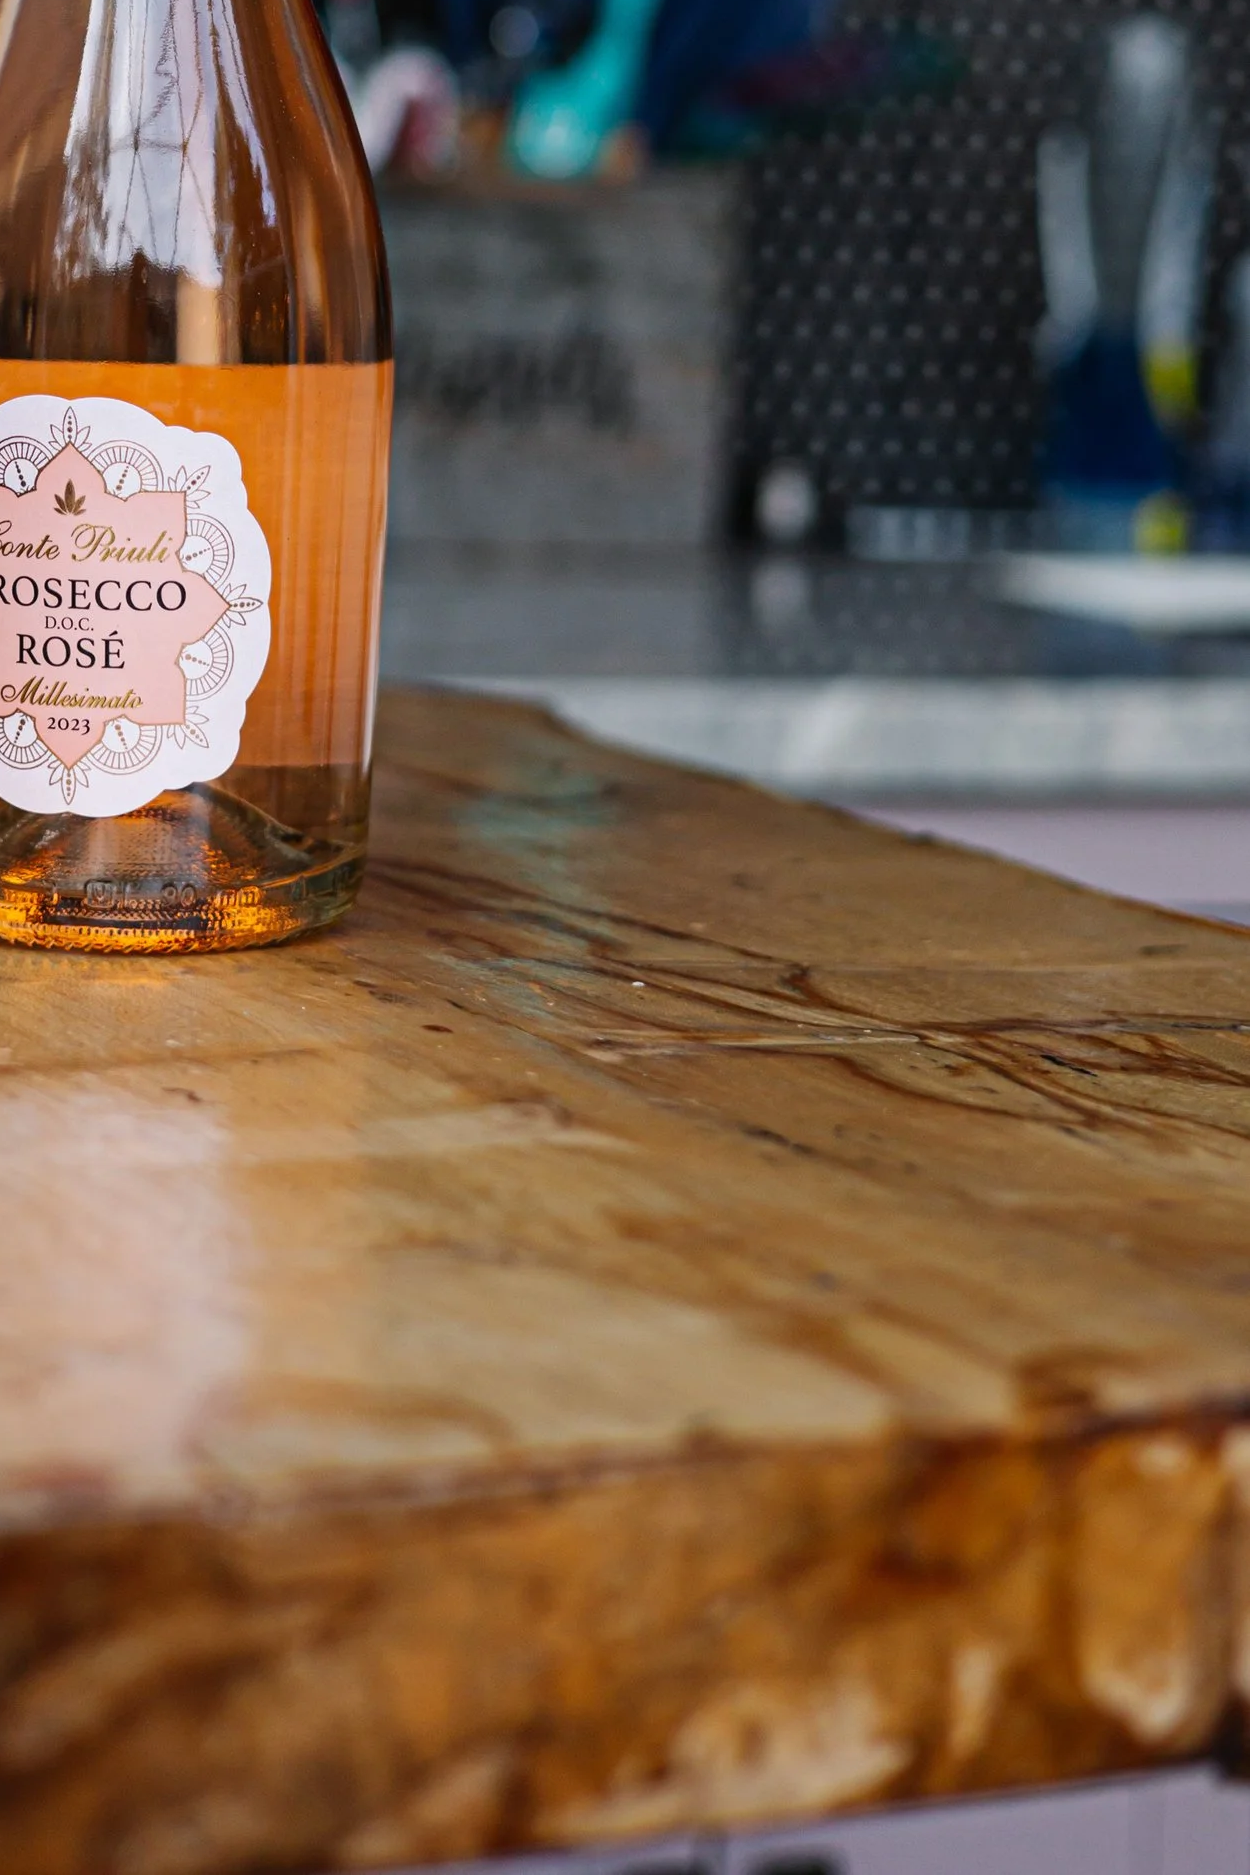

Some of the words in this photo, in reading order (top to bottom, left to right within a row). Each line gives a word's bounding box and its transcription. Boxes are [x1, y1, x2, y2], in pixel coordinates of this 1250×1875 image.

[71, 523, 173, 563] Priuli
[44, 616, 94, 631] D.O.C.
[16, 630, 125, 669] ROSÉ
[1, 675, 143, 709] Millesimato
[47, 717, 91, 735] 2023
